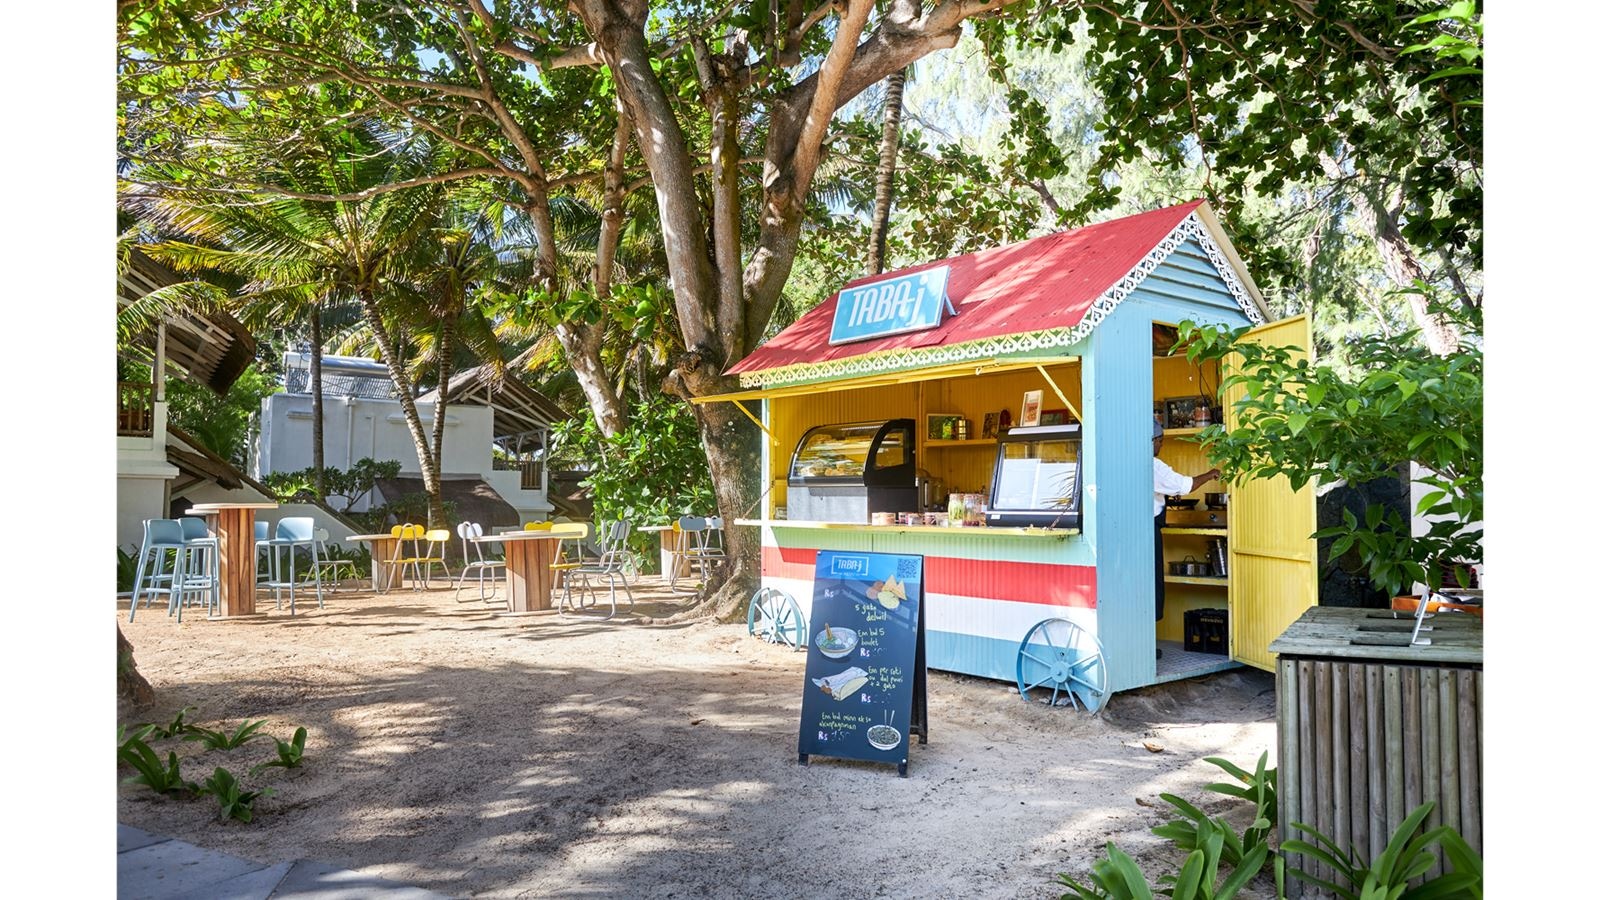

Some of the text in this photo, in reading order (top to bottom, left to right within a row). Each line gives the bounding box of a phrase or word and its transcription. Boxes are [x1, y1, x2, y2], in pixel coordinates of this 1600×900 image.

[824, 588, 834, 598] Rs
[861, 603, 877, 615] gato
[879, 627, 885, 636] 5
[860, 647, 870, 657] Rs
[882, 682, 896, 692] gato
[861, 693, 871, 703] Rs
[818, 730, 828, 741] Rs
